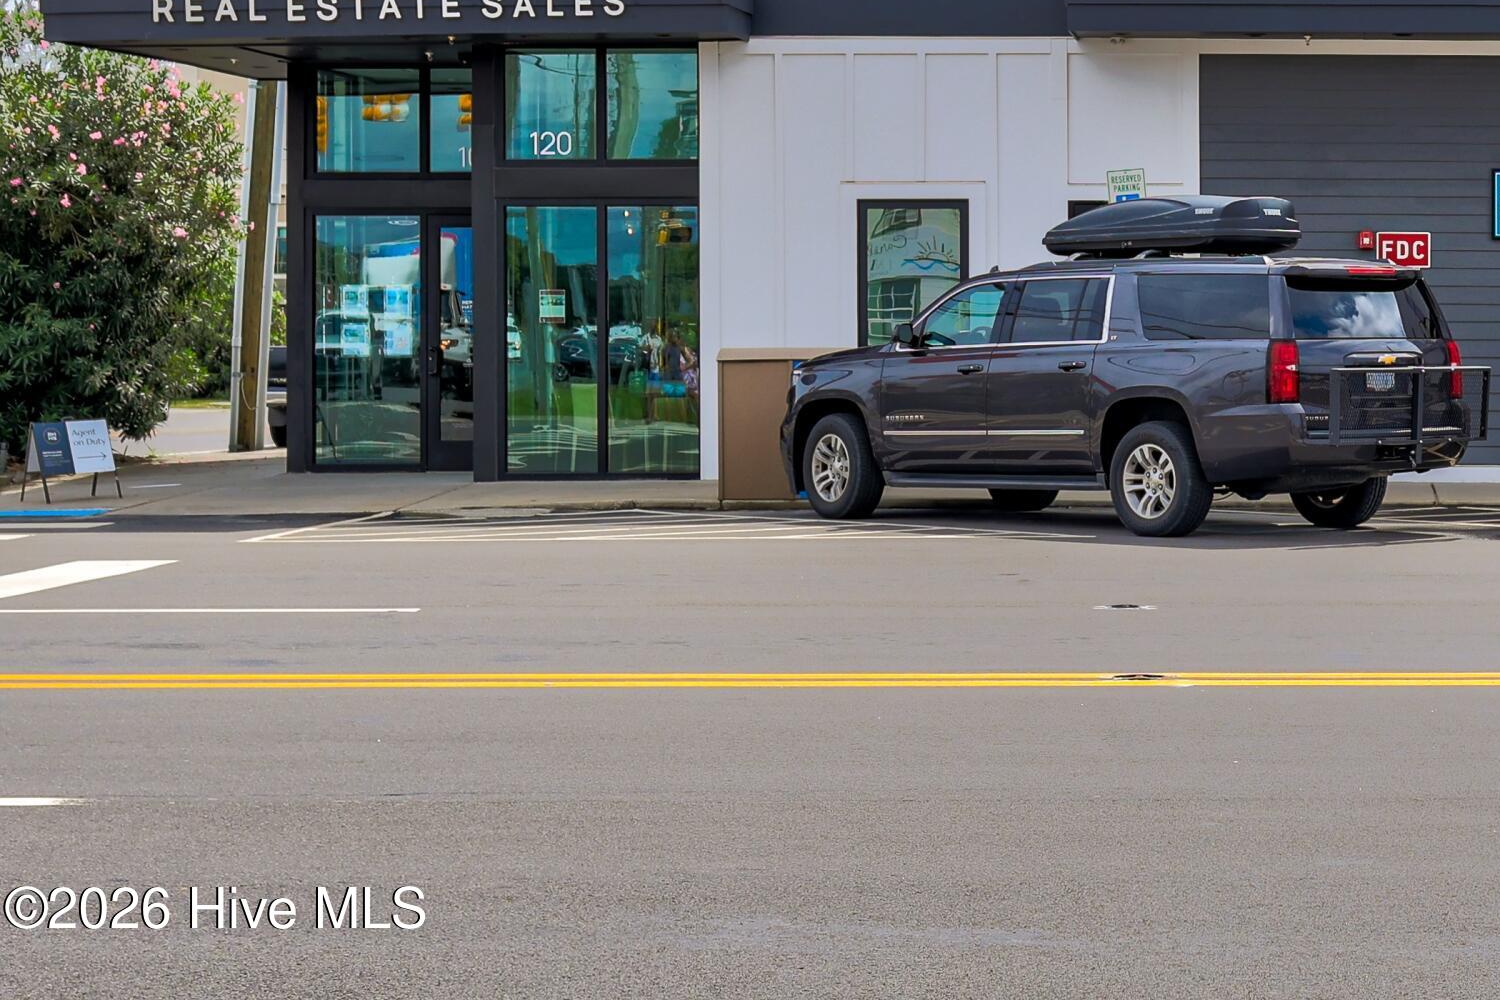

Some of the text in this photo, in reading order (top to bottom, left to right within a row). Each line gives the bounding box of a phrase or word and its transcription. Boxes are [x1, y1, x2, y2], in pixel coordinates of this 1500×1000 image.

[529, 131, 572, 156] 120
[1110, 174, 1142, 184] RESERVED
[1113, 183, 1141, 192] PARKING
[1382, 240, 1425, 260] FDC
